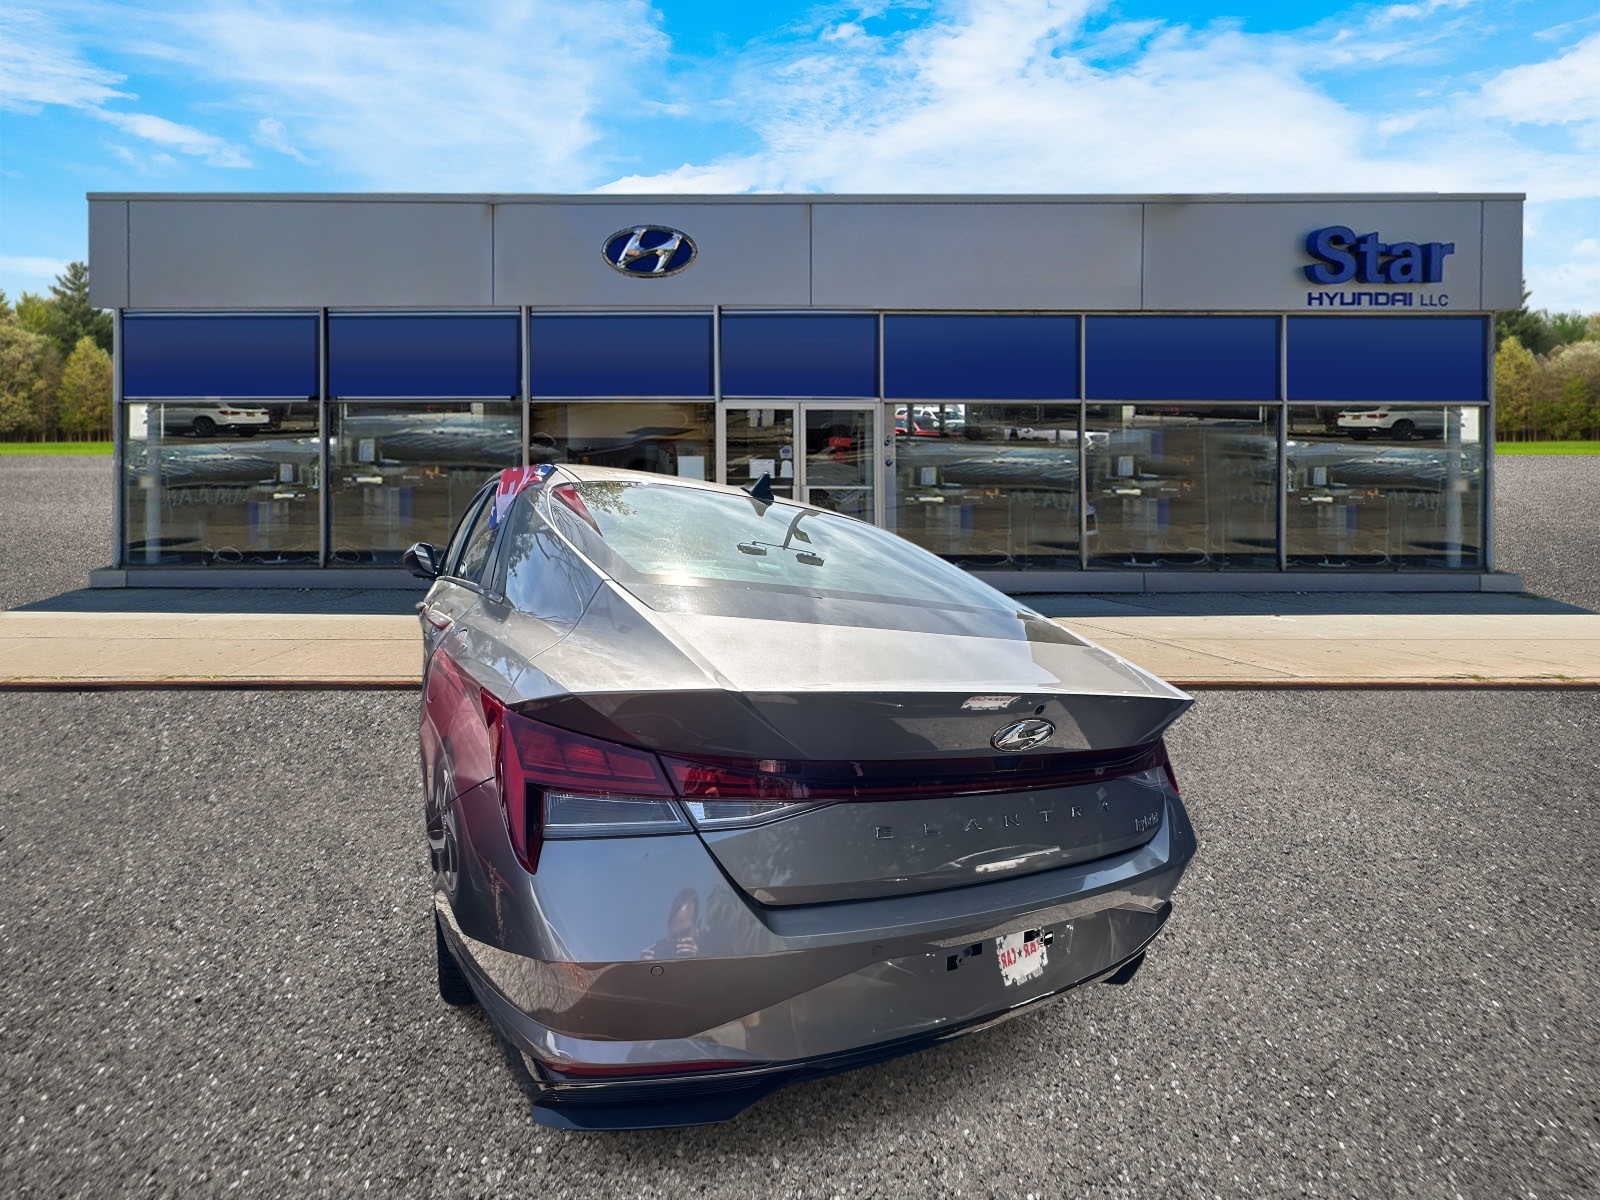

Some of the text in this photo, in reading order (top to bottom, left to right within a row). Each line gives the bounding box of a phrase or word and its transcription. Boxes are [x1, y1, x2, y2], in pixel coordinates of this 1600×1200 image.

[1304, 225, 1455, 284] Star
[1307, 292, 1448, 306] HYUNDAI LLC
[874, 800, 1111, 840] ELANTRA
